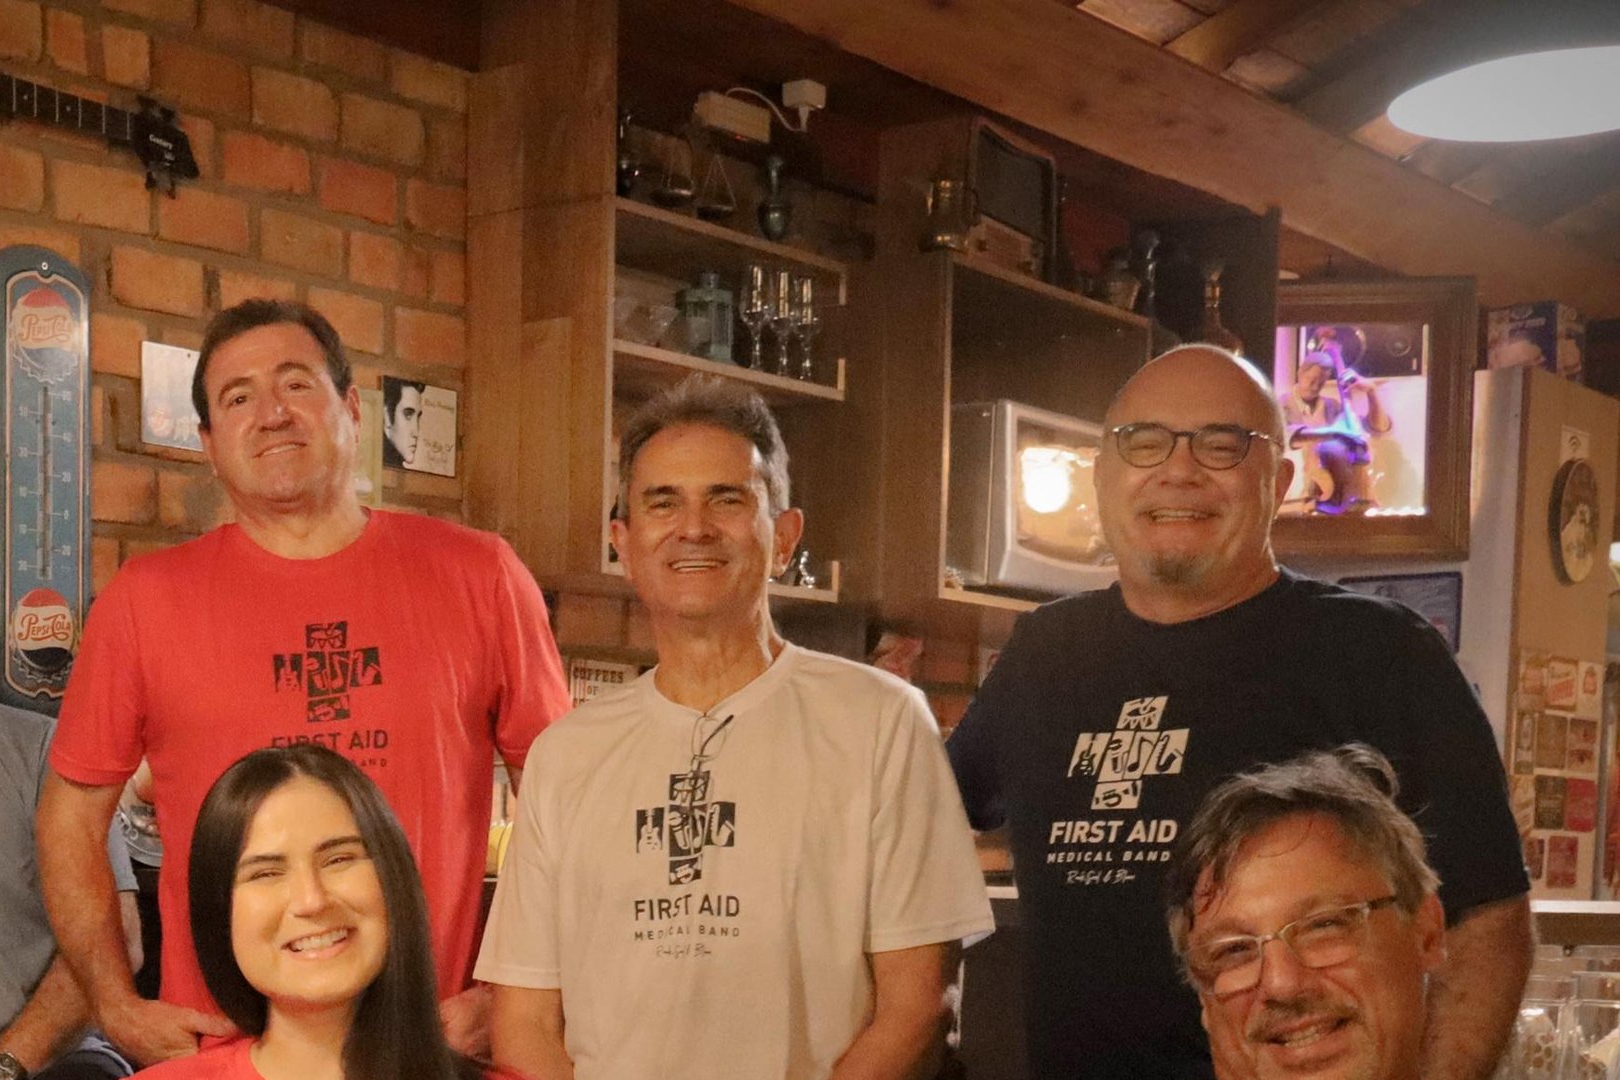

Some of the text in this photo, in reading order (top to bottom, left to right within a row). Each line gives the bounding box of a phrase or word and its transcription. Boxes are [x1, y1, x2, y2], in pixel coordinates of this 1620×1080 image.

[573, 666, 624, 684] COFFEES
[348, 729, 388, 750] AID
[1049, 819, 1178, 844] FIRST AID
[1046, 850, 1171, 864] MEDICAL BAND
[635, 893, 740, 921] FIRST AID
[634, 924, 740, 941] MEDICAL BAND
